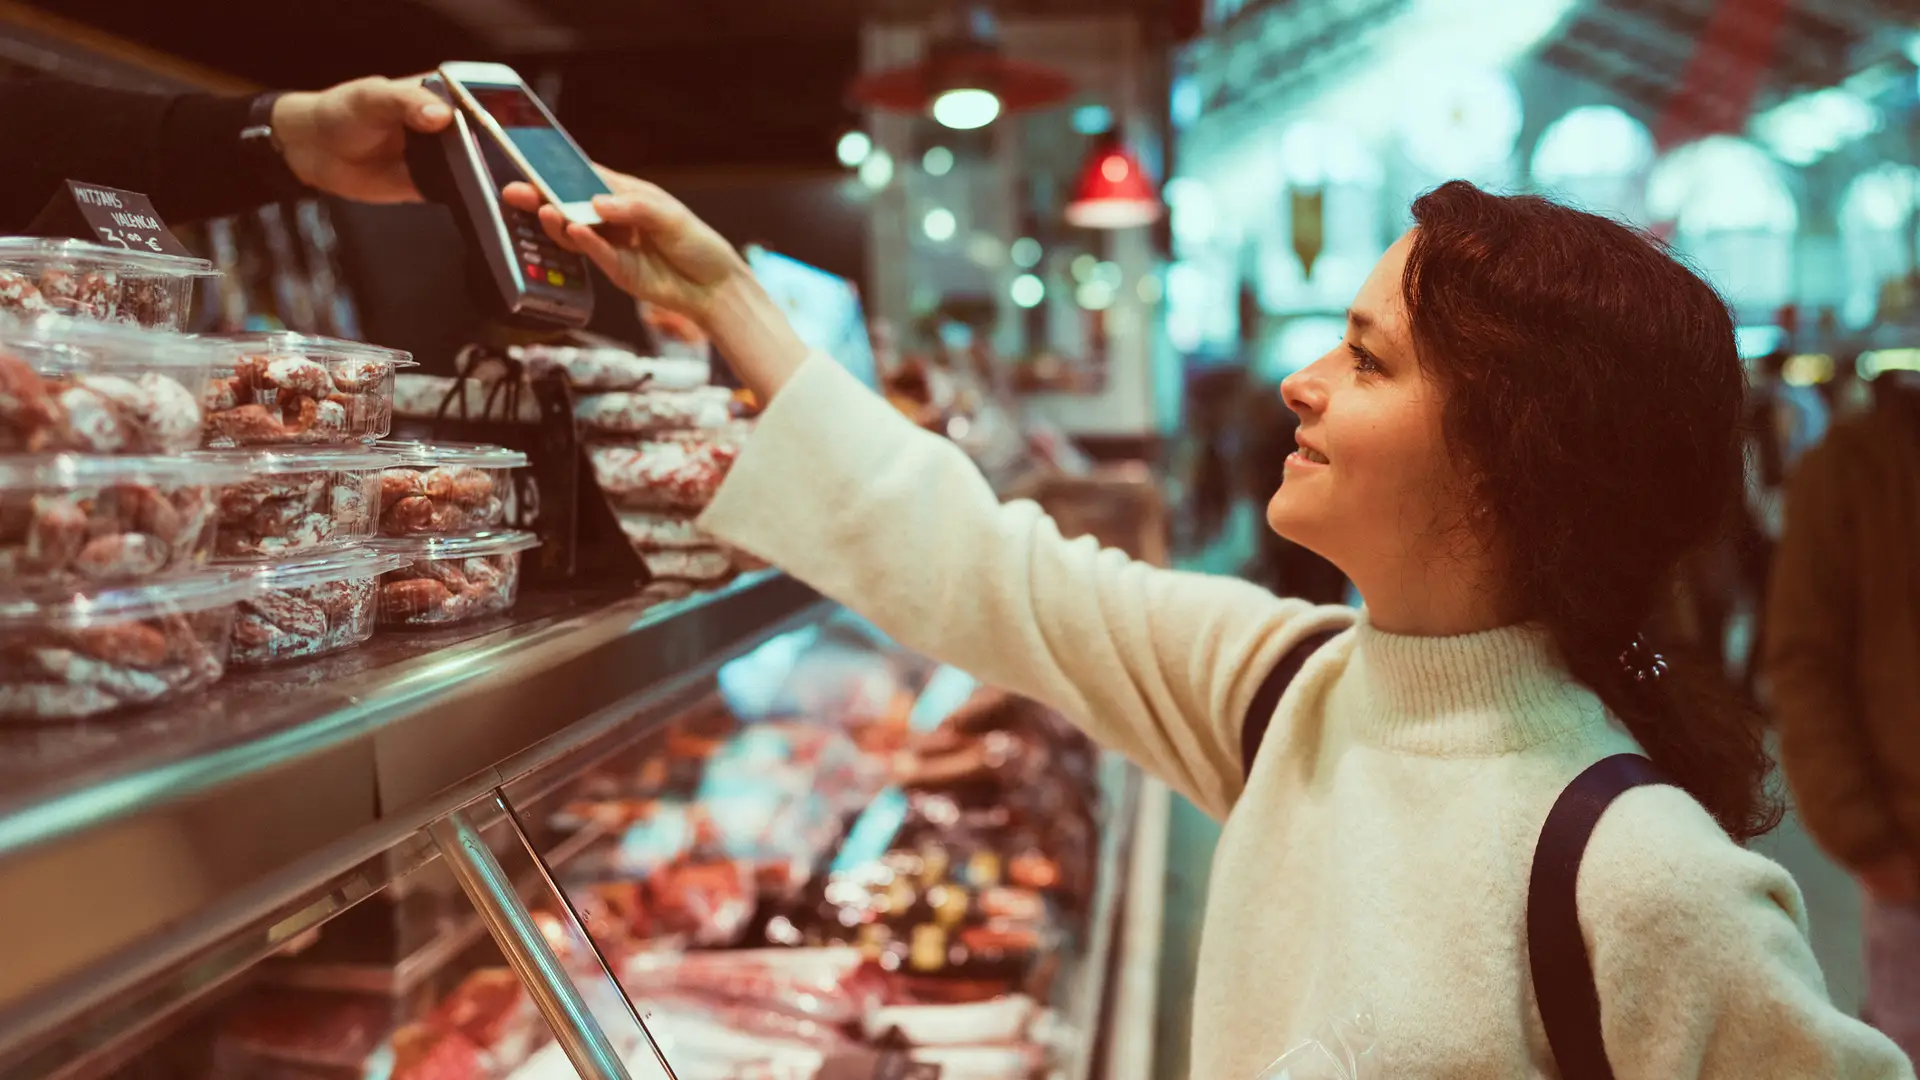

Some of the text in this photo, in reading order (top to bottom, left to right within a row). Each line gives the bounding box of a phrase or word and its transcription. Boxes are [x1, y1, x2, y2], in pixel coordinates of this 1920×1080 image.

[74, 187, 122, 209] MITJANS
[111, 212, 161, 231] VALENCIA
[145, 237, 163, 252] €
